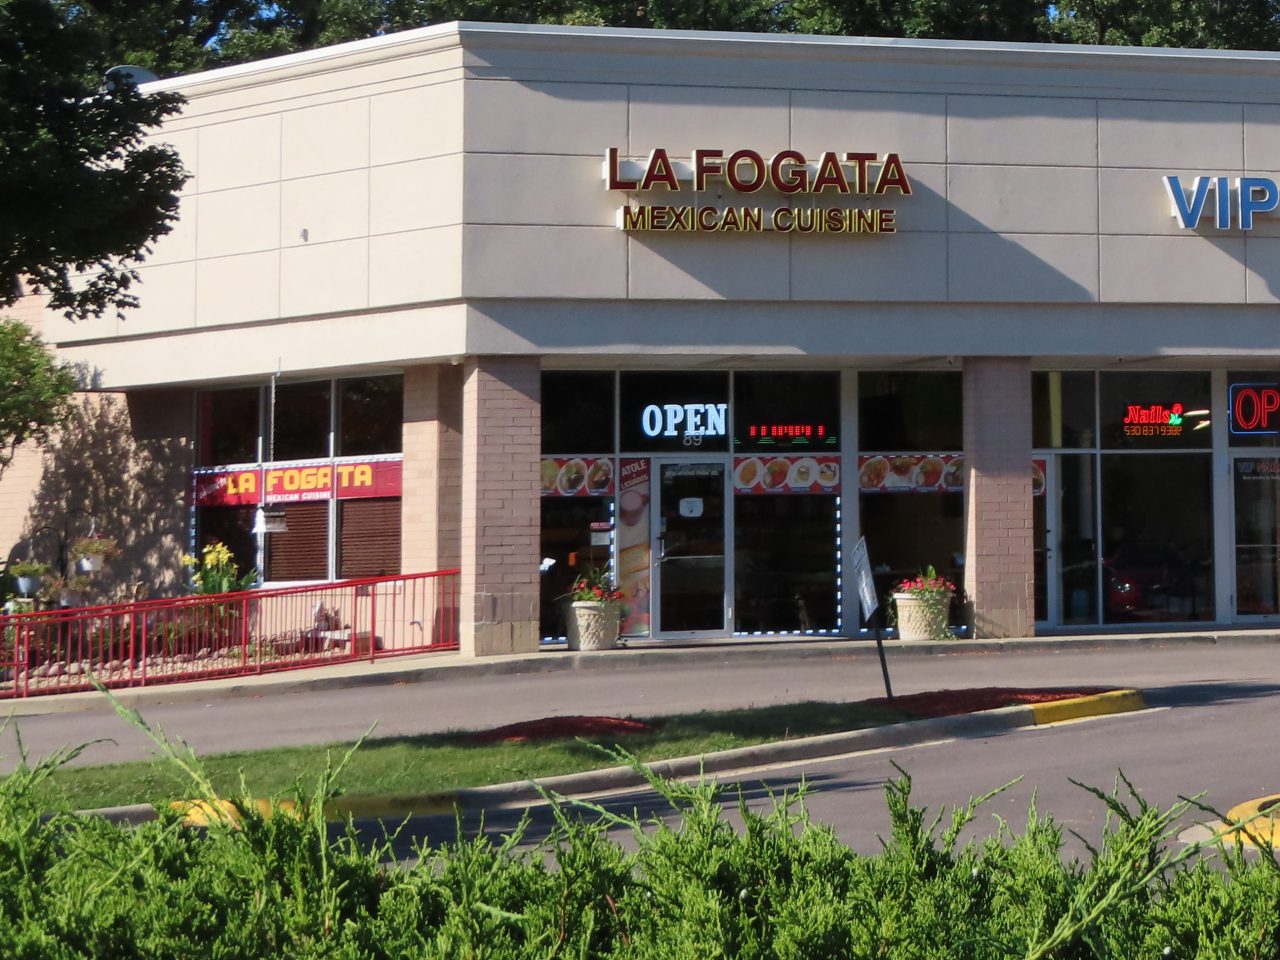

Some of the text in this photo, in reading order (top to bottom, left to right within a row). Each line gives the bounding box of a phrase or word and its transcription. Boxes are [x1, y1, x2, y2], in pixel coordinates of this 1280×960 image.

[604, 147, 912, 195] LA FOGATA
[1162, 175, 1280, 231] VIP
[620, 205, 897, 234] MEXICAN CUISINE
[642, 403, 728, 437] OPEN
[1123, 405, 1170, 424] Nails
[682, 431, 703, 446] 89
[227, 472, 256, 494] LA
[266, 465, 373, 491] FOGATA
[621, 459, 648, 477] ATOLE
[265, 491, 332, 502] MEXICAN CUISINE
